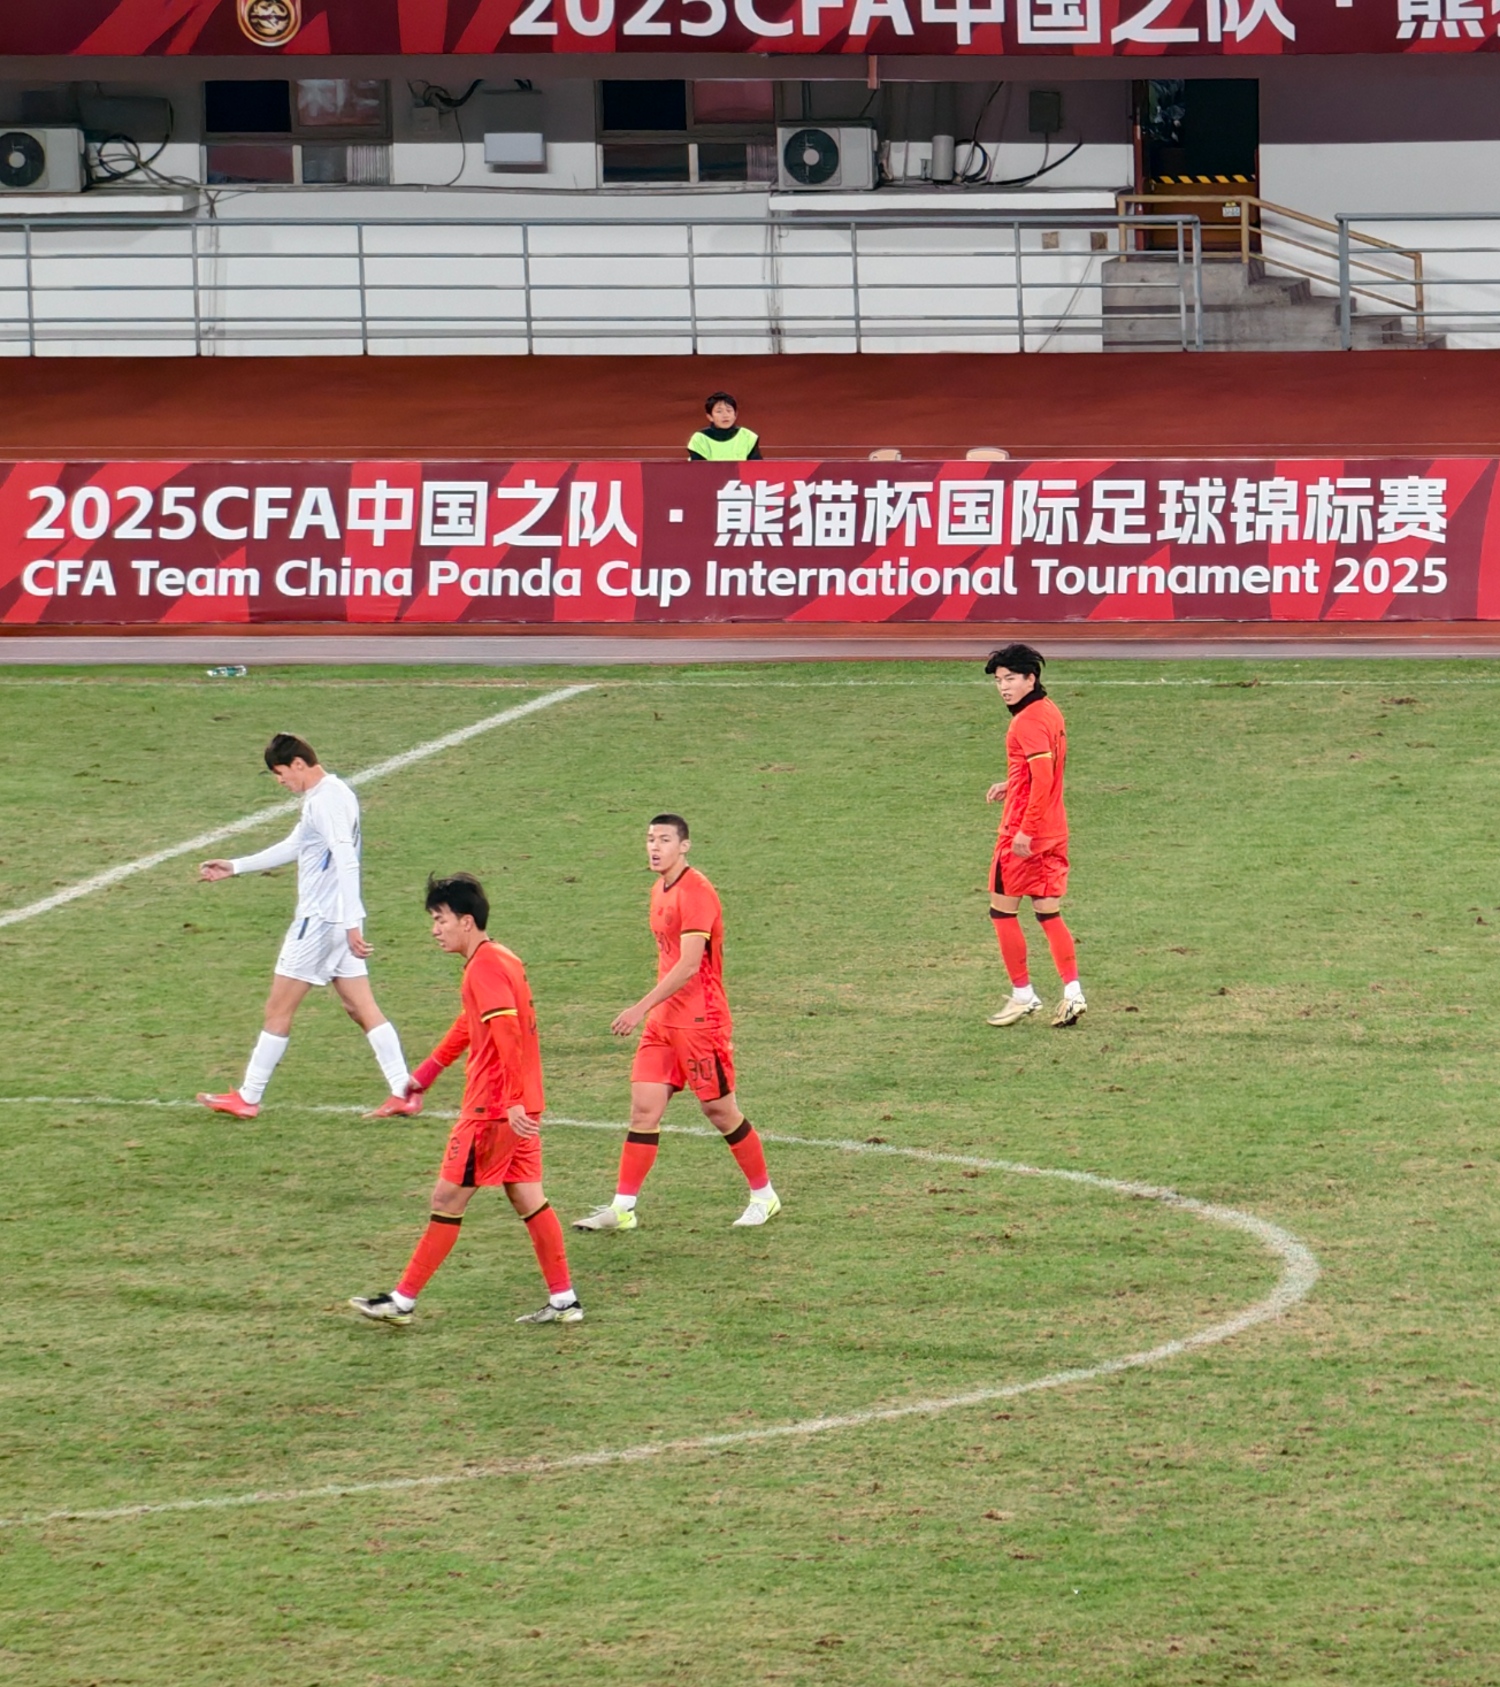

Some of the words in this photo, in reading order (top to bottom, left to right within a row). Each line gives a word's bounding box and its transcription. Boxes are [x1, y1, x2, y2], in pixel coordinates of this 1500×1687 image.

[23, 559, 116, 596] CFA
[131, 560, 260, 597] Team
[275, 557, 413, 597] China
[428, 557, 582, 597] Panda
[597, 560, 691, 608] Cup
[706, 556, 1018, 597] International
[1031, 558, 1320, 595] Tournament
[1334, 557, 1448, 594] 2025
[687, 1058, 713, 1081] 30
